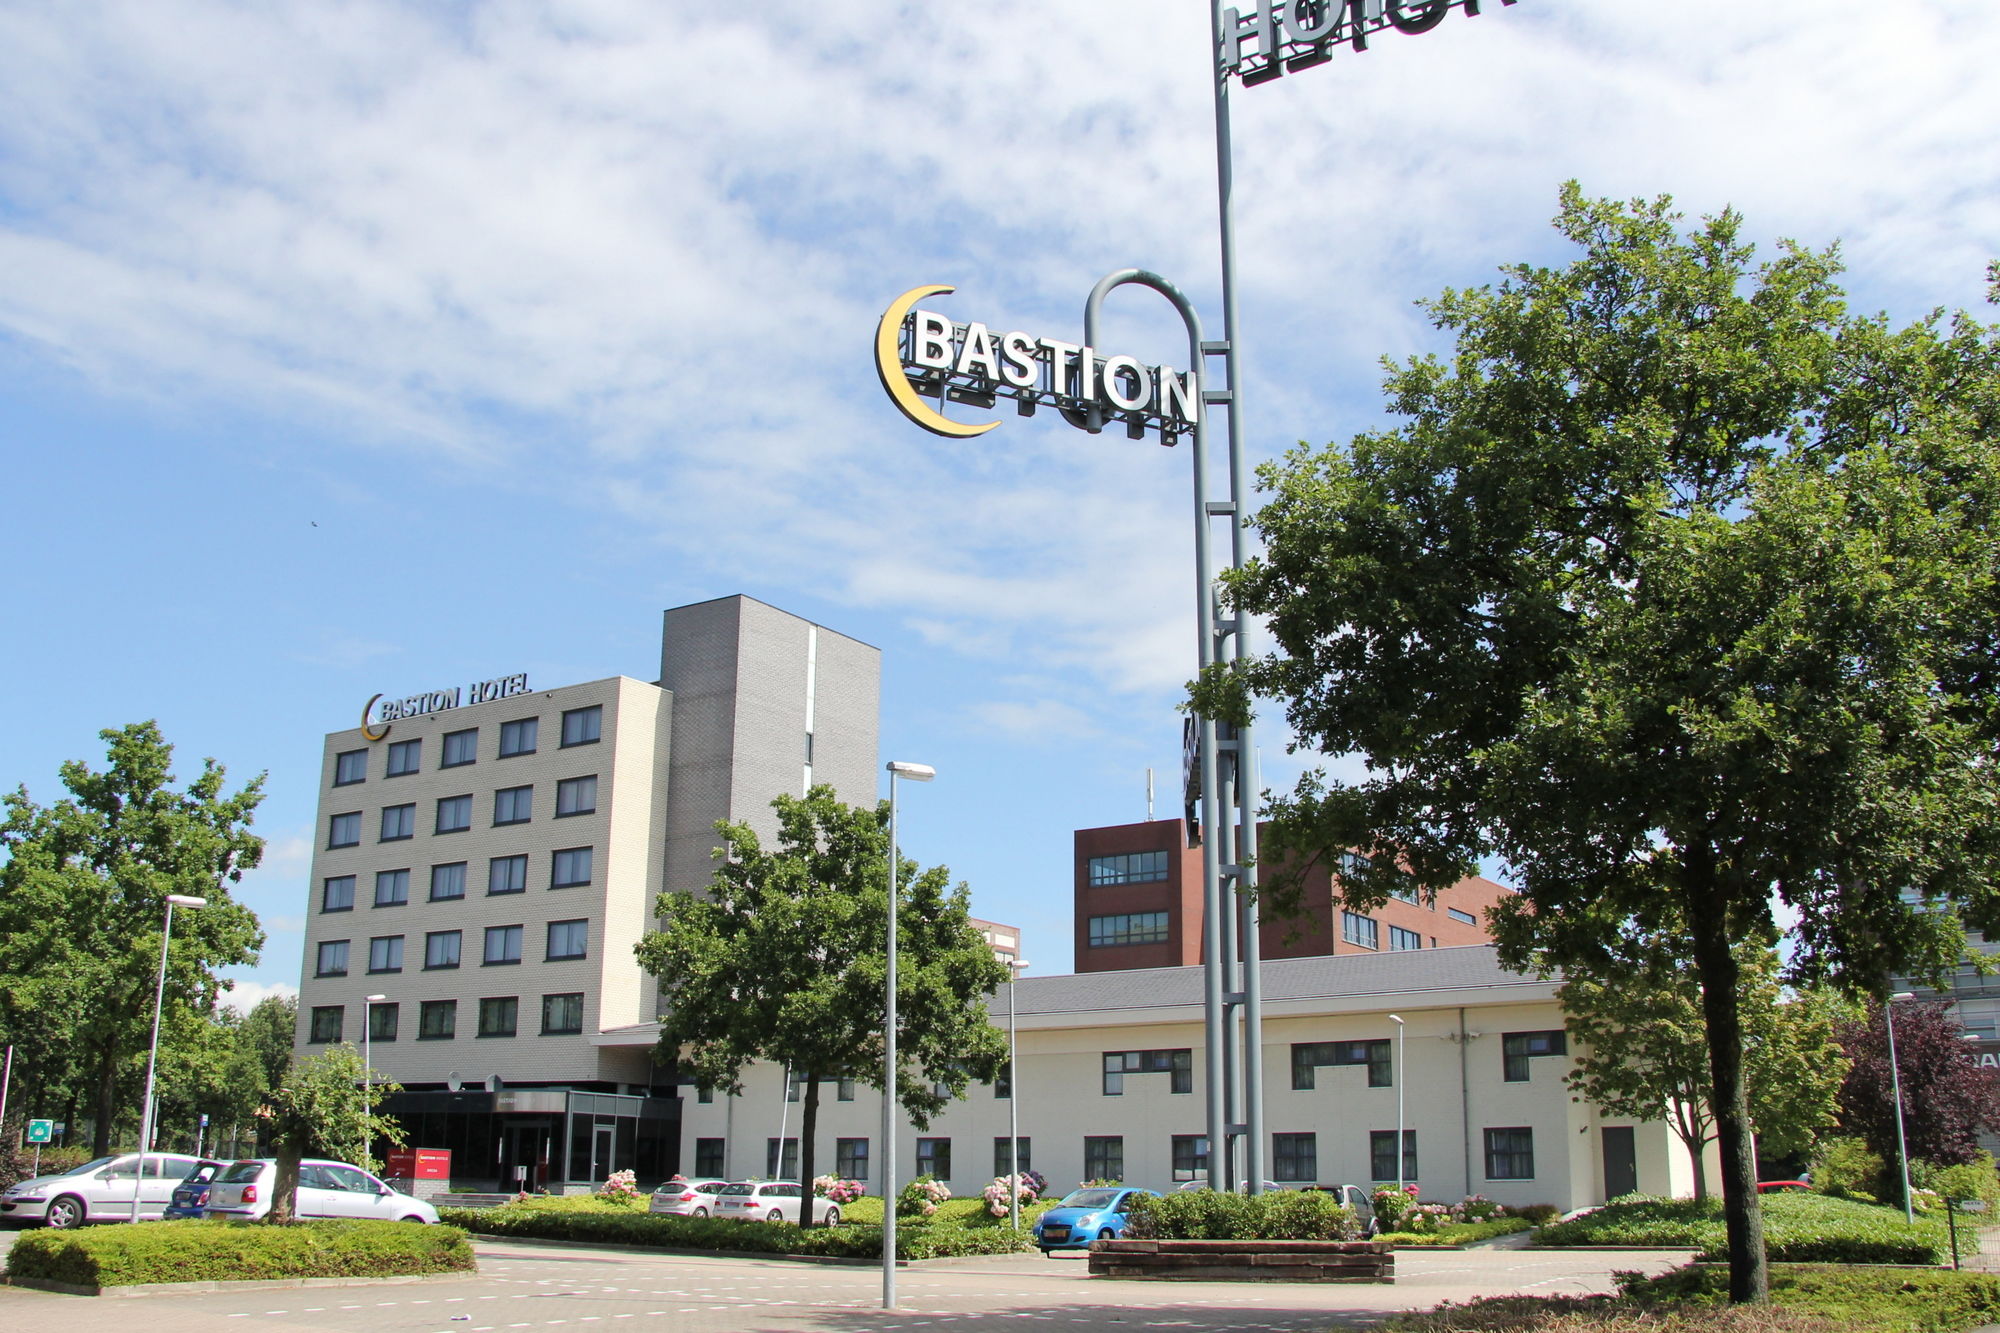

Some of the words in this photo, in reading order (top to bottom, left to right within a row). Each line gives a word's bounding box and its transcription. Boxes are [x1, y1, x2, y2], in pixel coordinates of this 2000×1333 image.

[914, 309, 1198, 424] BASTION
[379, 686, 461, 722] BASTION
[469, 672, 533, 705] HOTEL
